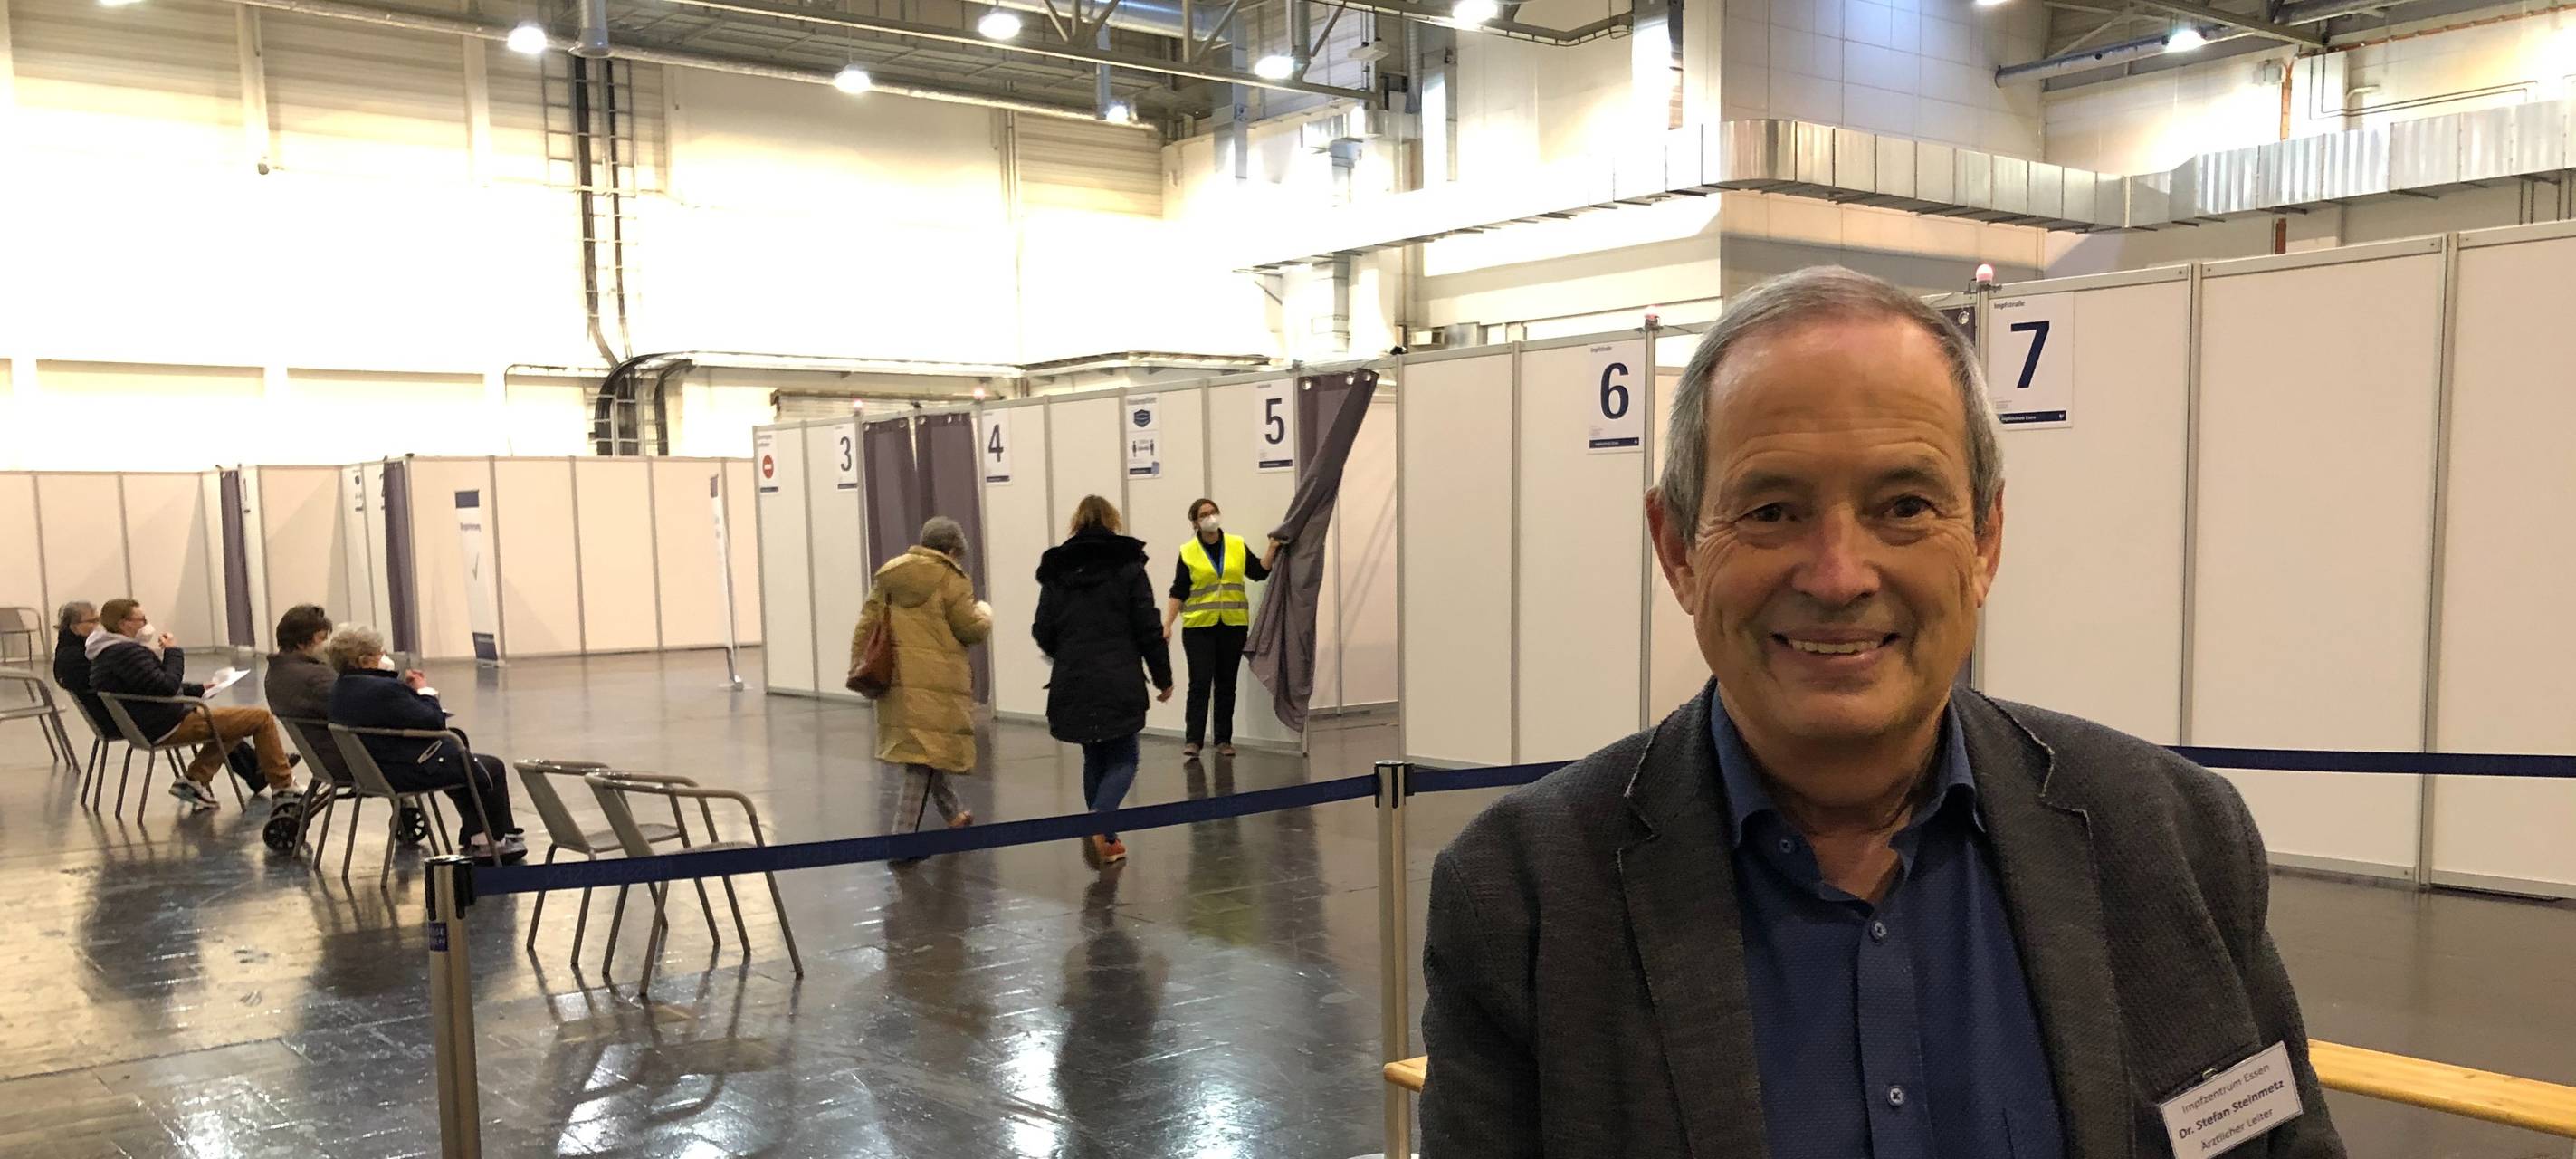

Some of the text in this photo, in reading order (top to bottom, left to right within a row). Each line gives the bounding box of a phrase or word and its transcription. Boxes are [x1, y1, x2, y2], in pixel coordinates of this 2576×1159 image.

[2010, 321, 2050, 388] 7
[1600, 362, 1629, 419] 6
[988, 424, 1004, 462] 4
[1265, 398, 1285, 445] 5
[840, 436, 852, 472] 3
[2179, 1079, 2285, 1139] Dr. Stefan Steinmetz
[2182, 1064, 2270, 1114] Impfzentrum Essen
[2247, 1107, 2274, 1127] Leiter
